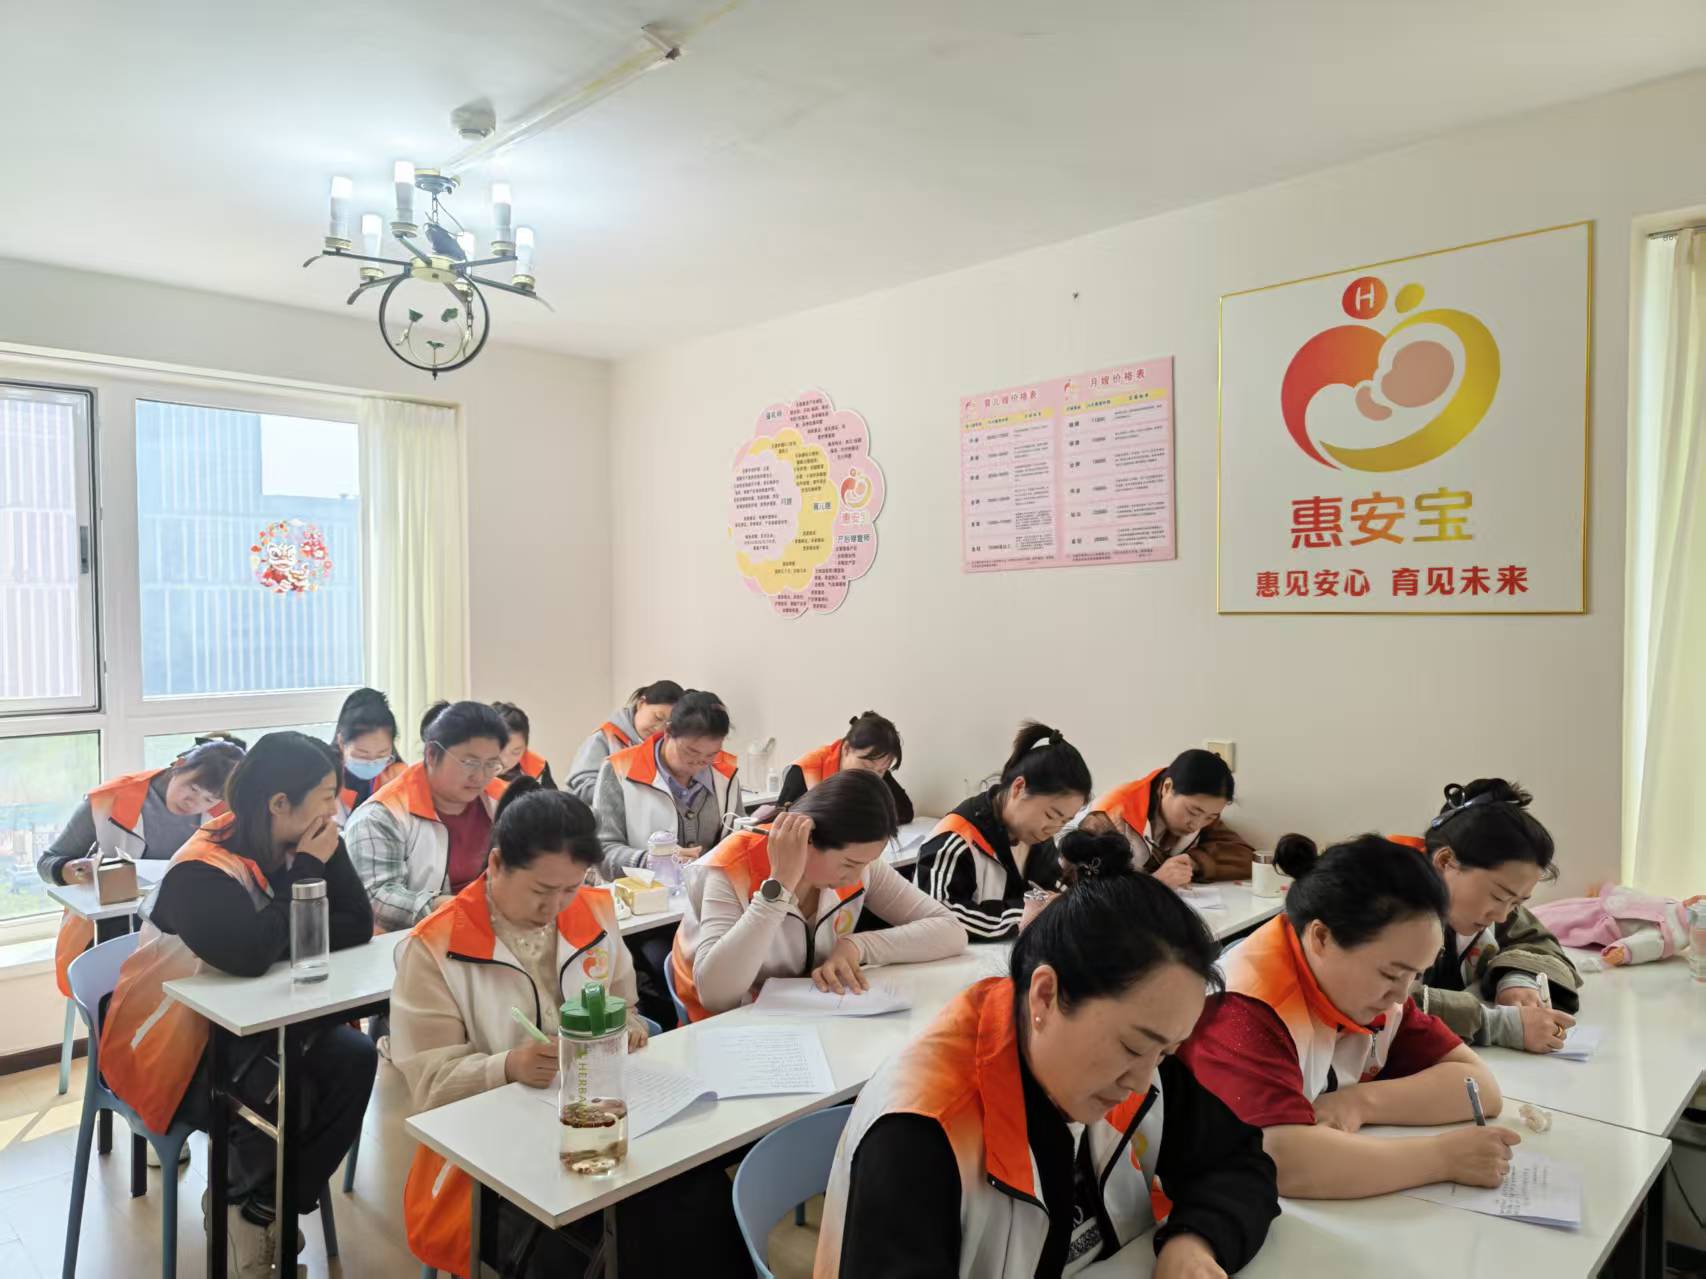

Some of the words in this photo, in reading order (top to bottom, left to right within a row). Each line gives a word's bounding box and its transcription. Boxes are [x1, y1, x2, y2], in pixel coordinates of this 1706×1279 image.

[1355, 283, 1375, 311] H
[1290, 487, 1473, 549] 惠安宝
[1256, 569, 1371, 598] 惠见安心
[1391, 565, 1529, 597] 育见未来
